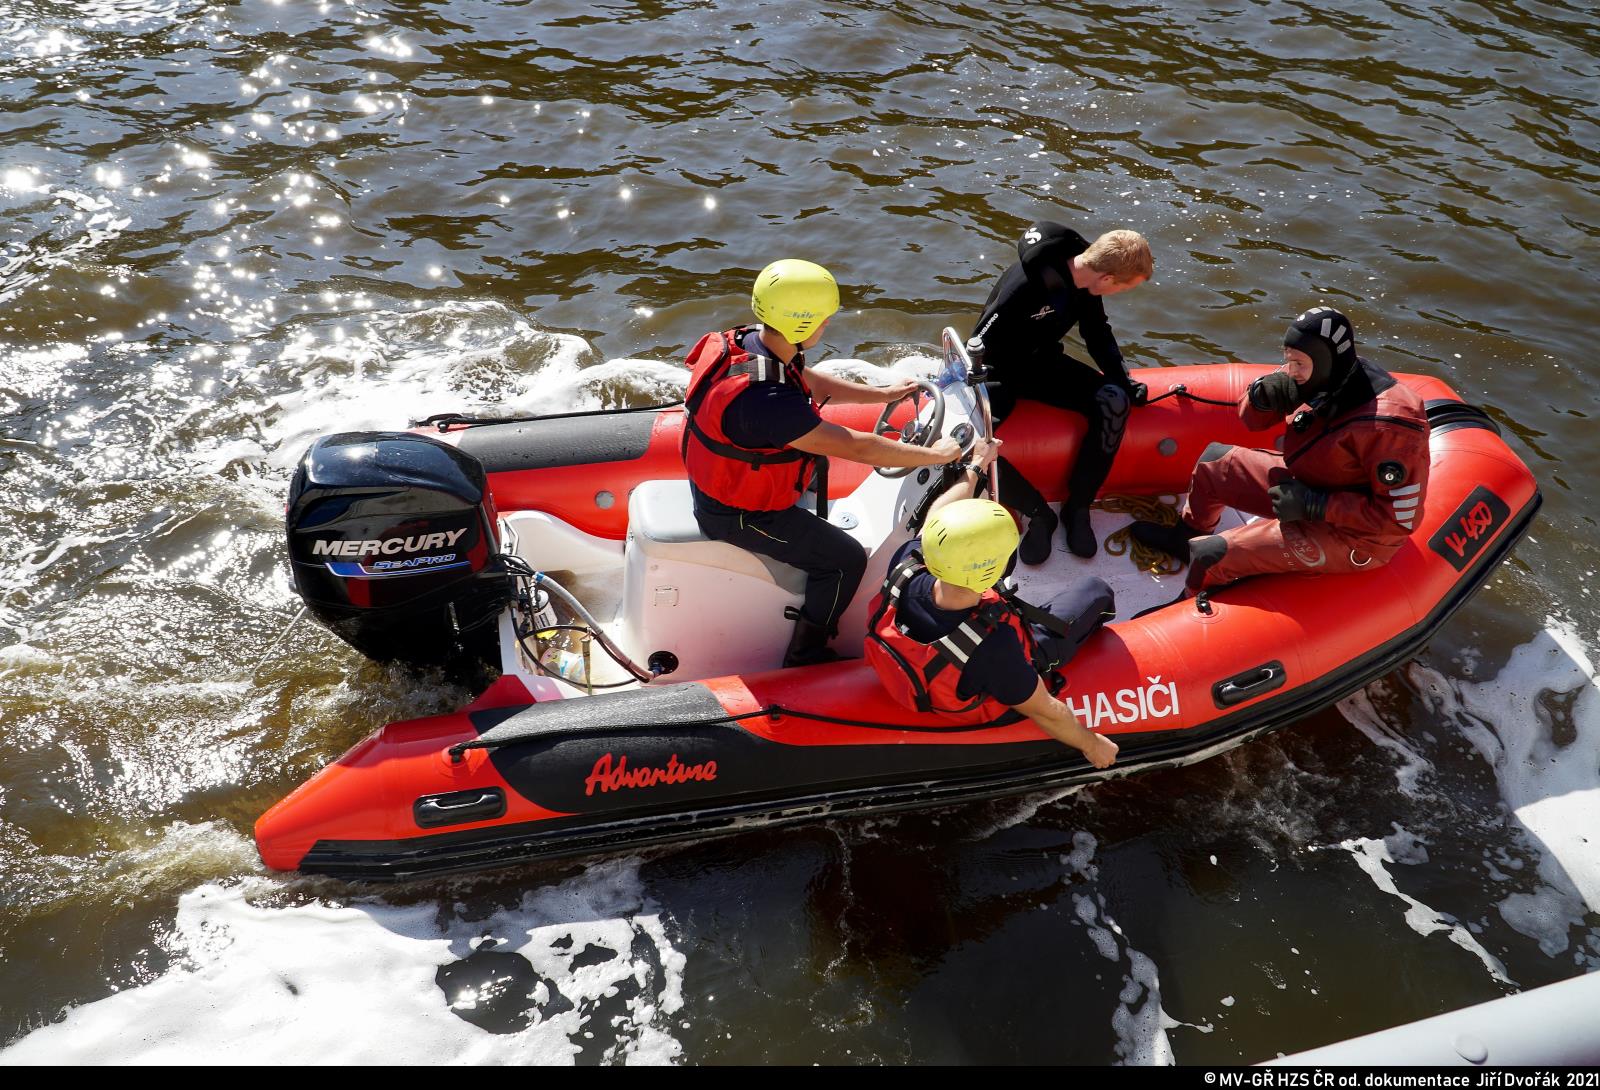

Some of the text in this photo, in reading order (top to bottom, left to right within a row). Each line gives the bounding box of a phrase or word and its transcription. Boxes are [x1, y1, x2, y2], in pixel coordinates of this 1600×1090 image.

[977, 313, 999, 338] CUBAPRO
[312, 527, 468, 556] MERCURY
[1066, 675, 1179, 729] HASIČI
[585, 752, 717, 796] Adventure
